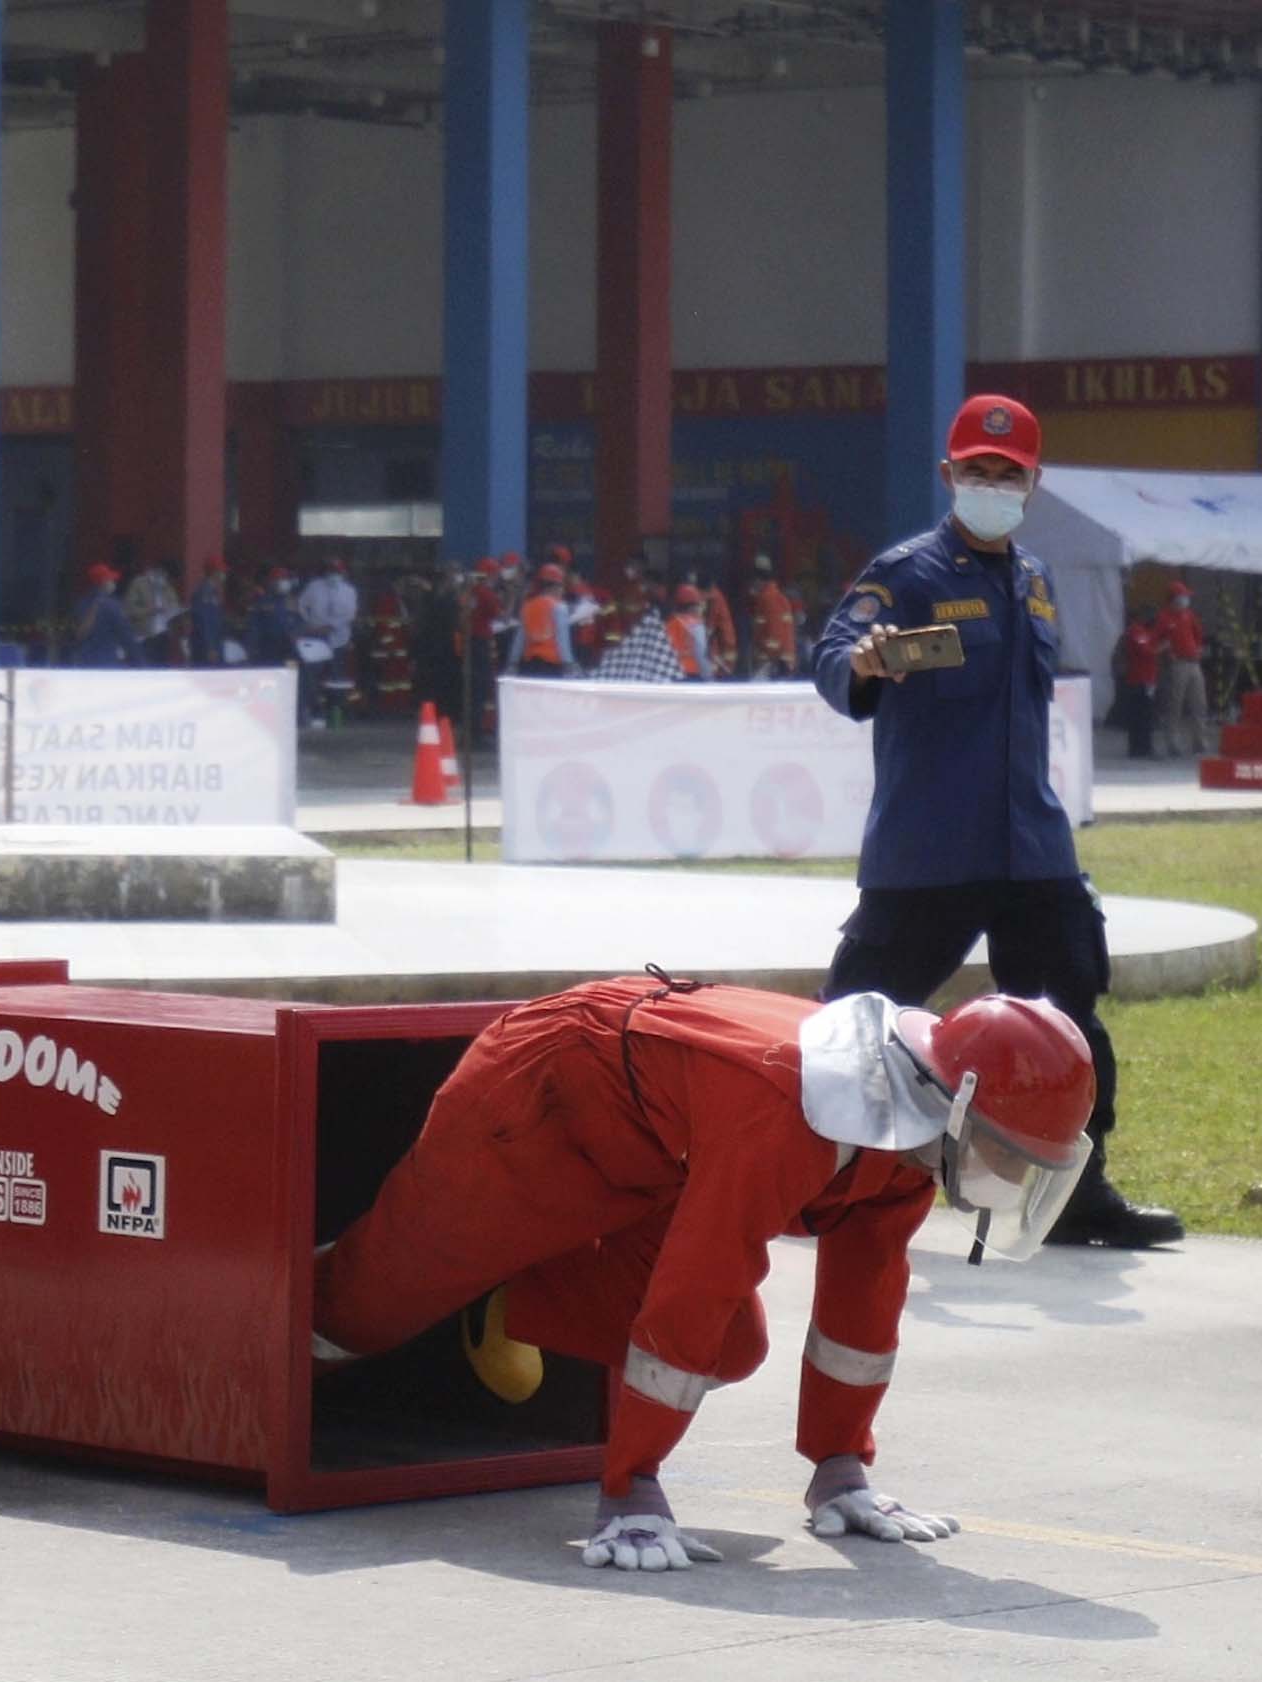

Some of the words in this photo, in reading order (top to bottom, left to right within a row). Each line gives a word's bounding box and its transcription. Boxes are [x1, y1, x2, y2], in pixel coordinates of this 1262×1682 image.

[1065, 362, 1230, 402] IKHLAS
[14, 1186, 42, 1199] SINCE
[14, 1199, 42, 1215] 1886
[107, 1213, 155, 1234] NFPA
